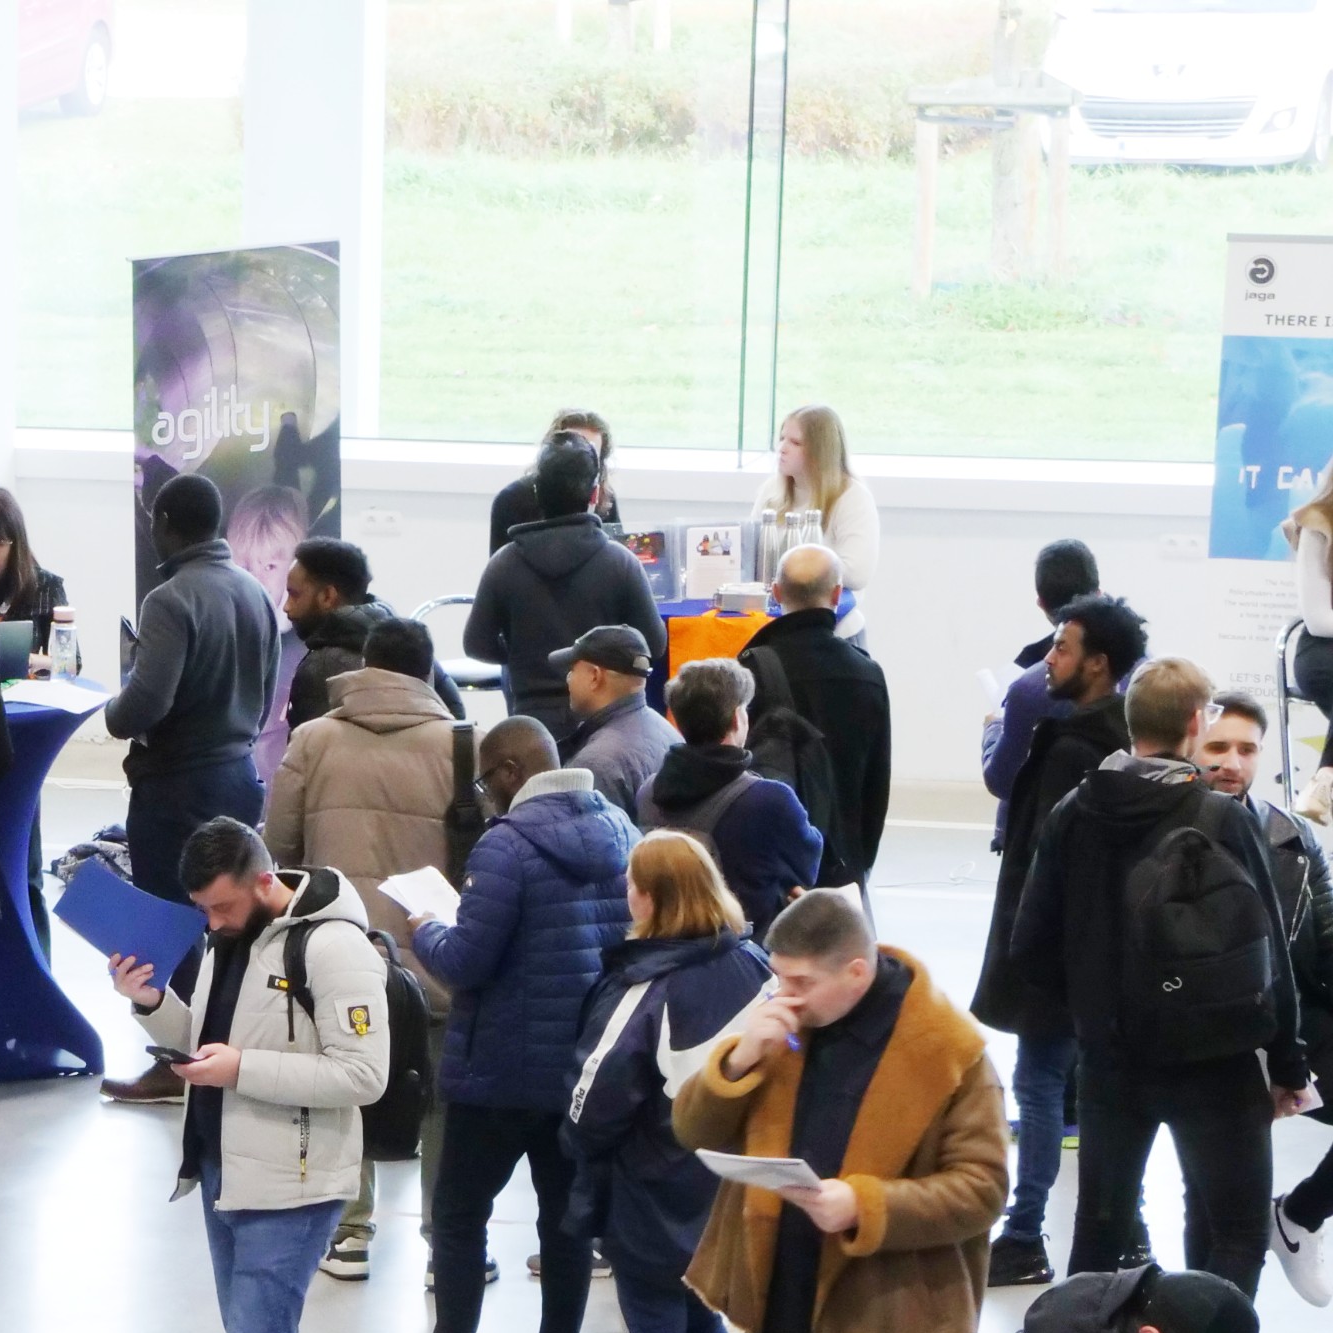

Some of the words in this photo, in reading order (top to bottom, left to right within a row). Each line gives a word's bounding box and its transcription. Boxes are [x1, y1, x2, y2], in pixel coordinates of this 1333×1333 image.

[1244, 289, 1276, 302] jaga
[1264, 313, 1318, 327] THERE
[151, 384, 270, 460] agility
[1238, 465, 1262, 489] IT
